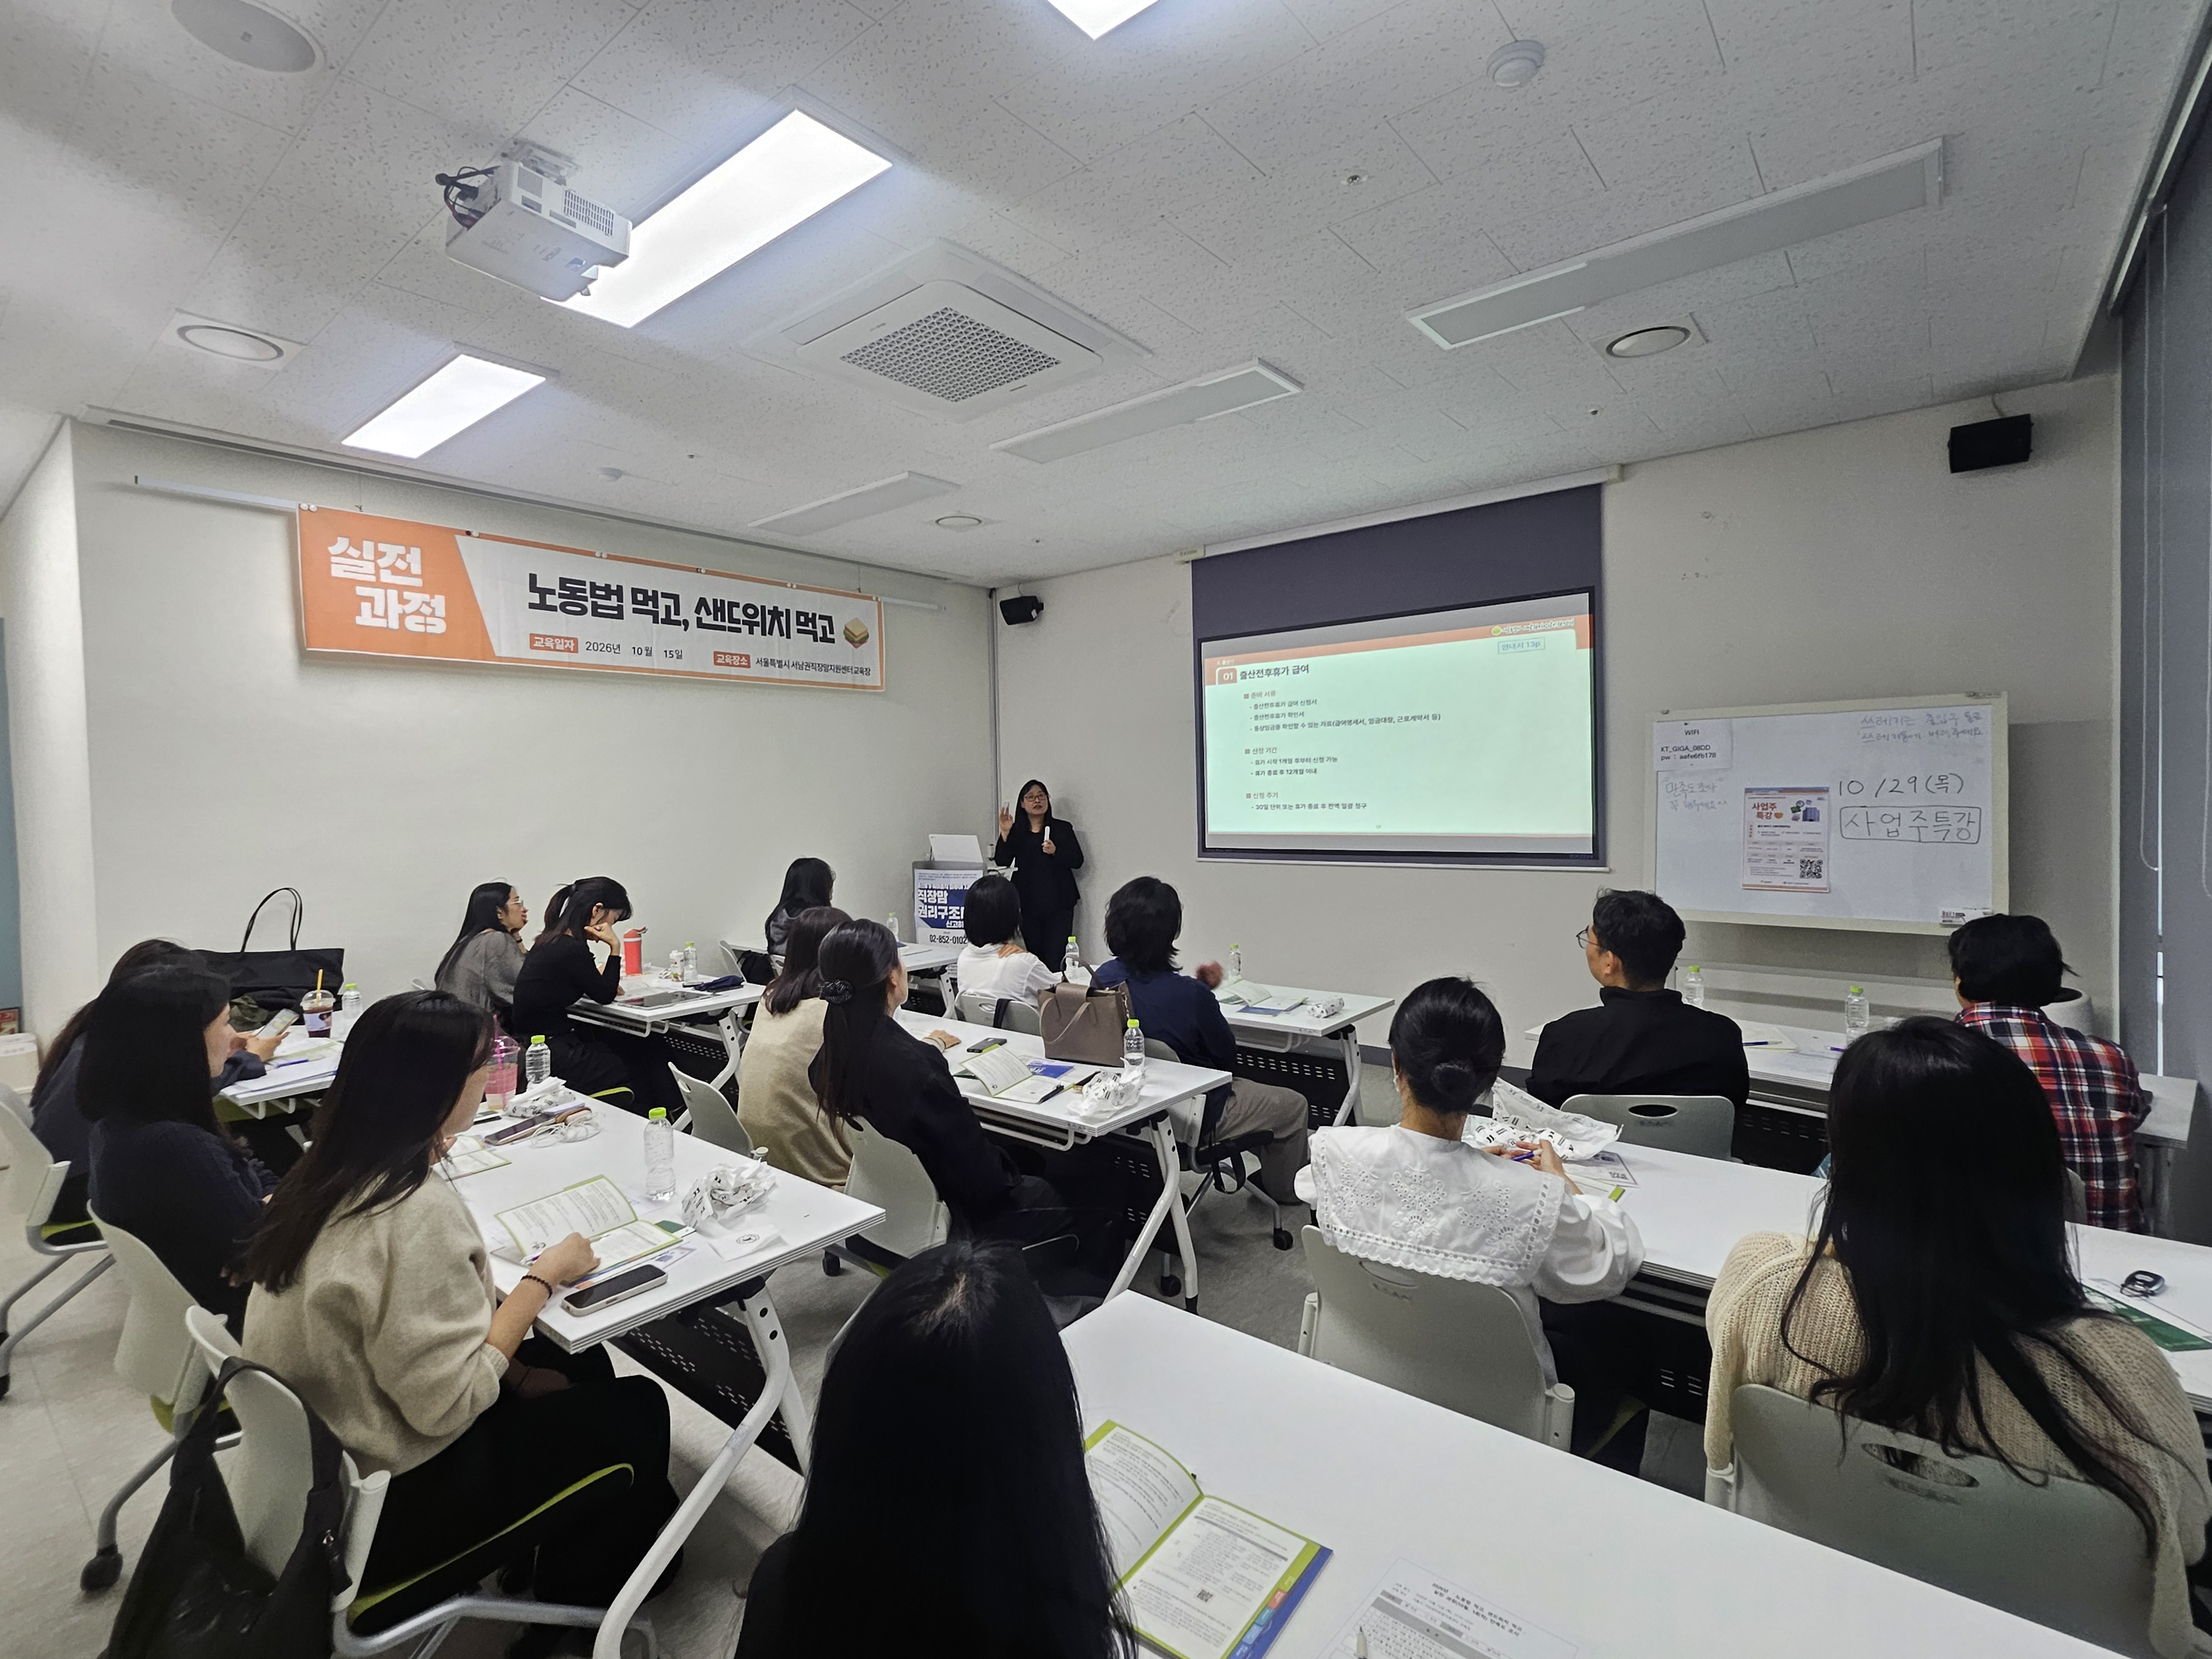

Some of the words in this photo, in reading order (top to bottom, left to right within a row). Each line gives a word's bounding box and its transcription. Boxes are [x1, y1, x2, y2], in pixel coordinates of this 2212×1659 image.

[328, 536, 422, 587] 실전
[355, 586, 447, 634] 과정
[528, 572, 624, 620] 노동법
[630, 587, 690, 632] 먹고,
[695, 596, 791, 640] 샌드위치
[795, 609, 836, 644] 먹고
[533, 636, 575, 651] 교육일자
[585, 641, 621, 654] 2026년
[664, 649, 683, 660] 15일
[1501, 643, 1524, 651] 안내서
[716, 654, 748, 666] 교육장소
[756, 656, 790, 670] 서울특별시
[1223, 672, 1234, 681] 01
[1240, 666, 1289, 680] 출산전후휴가
[1292, 664, 1310, 675] 급여
[1861, 715, 1915, 729] 쓰레기는
[1752, 802, 1777, 811] 사업주
[1756, 811, 1773, 820] 특강
[917, 889, 948, 904] 직장맘
[929, 935, 968, 945] 02-852-0102
